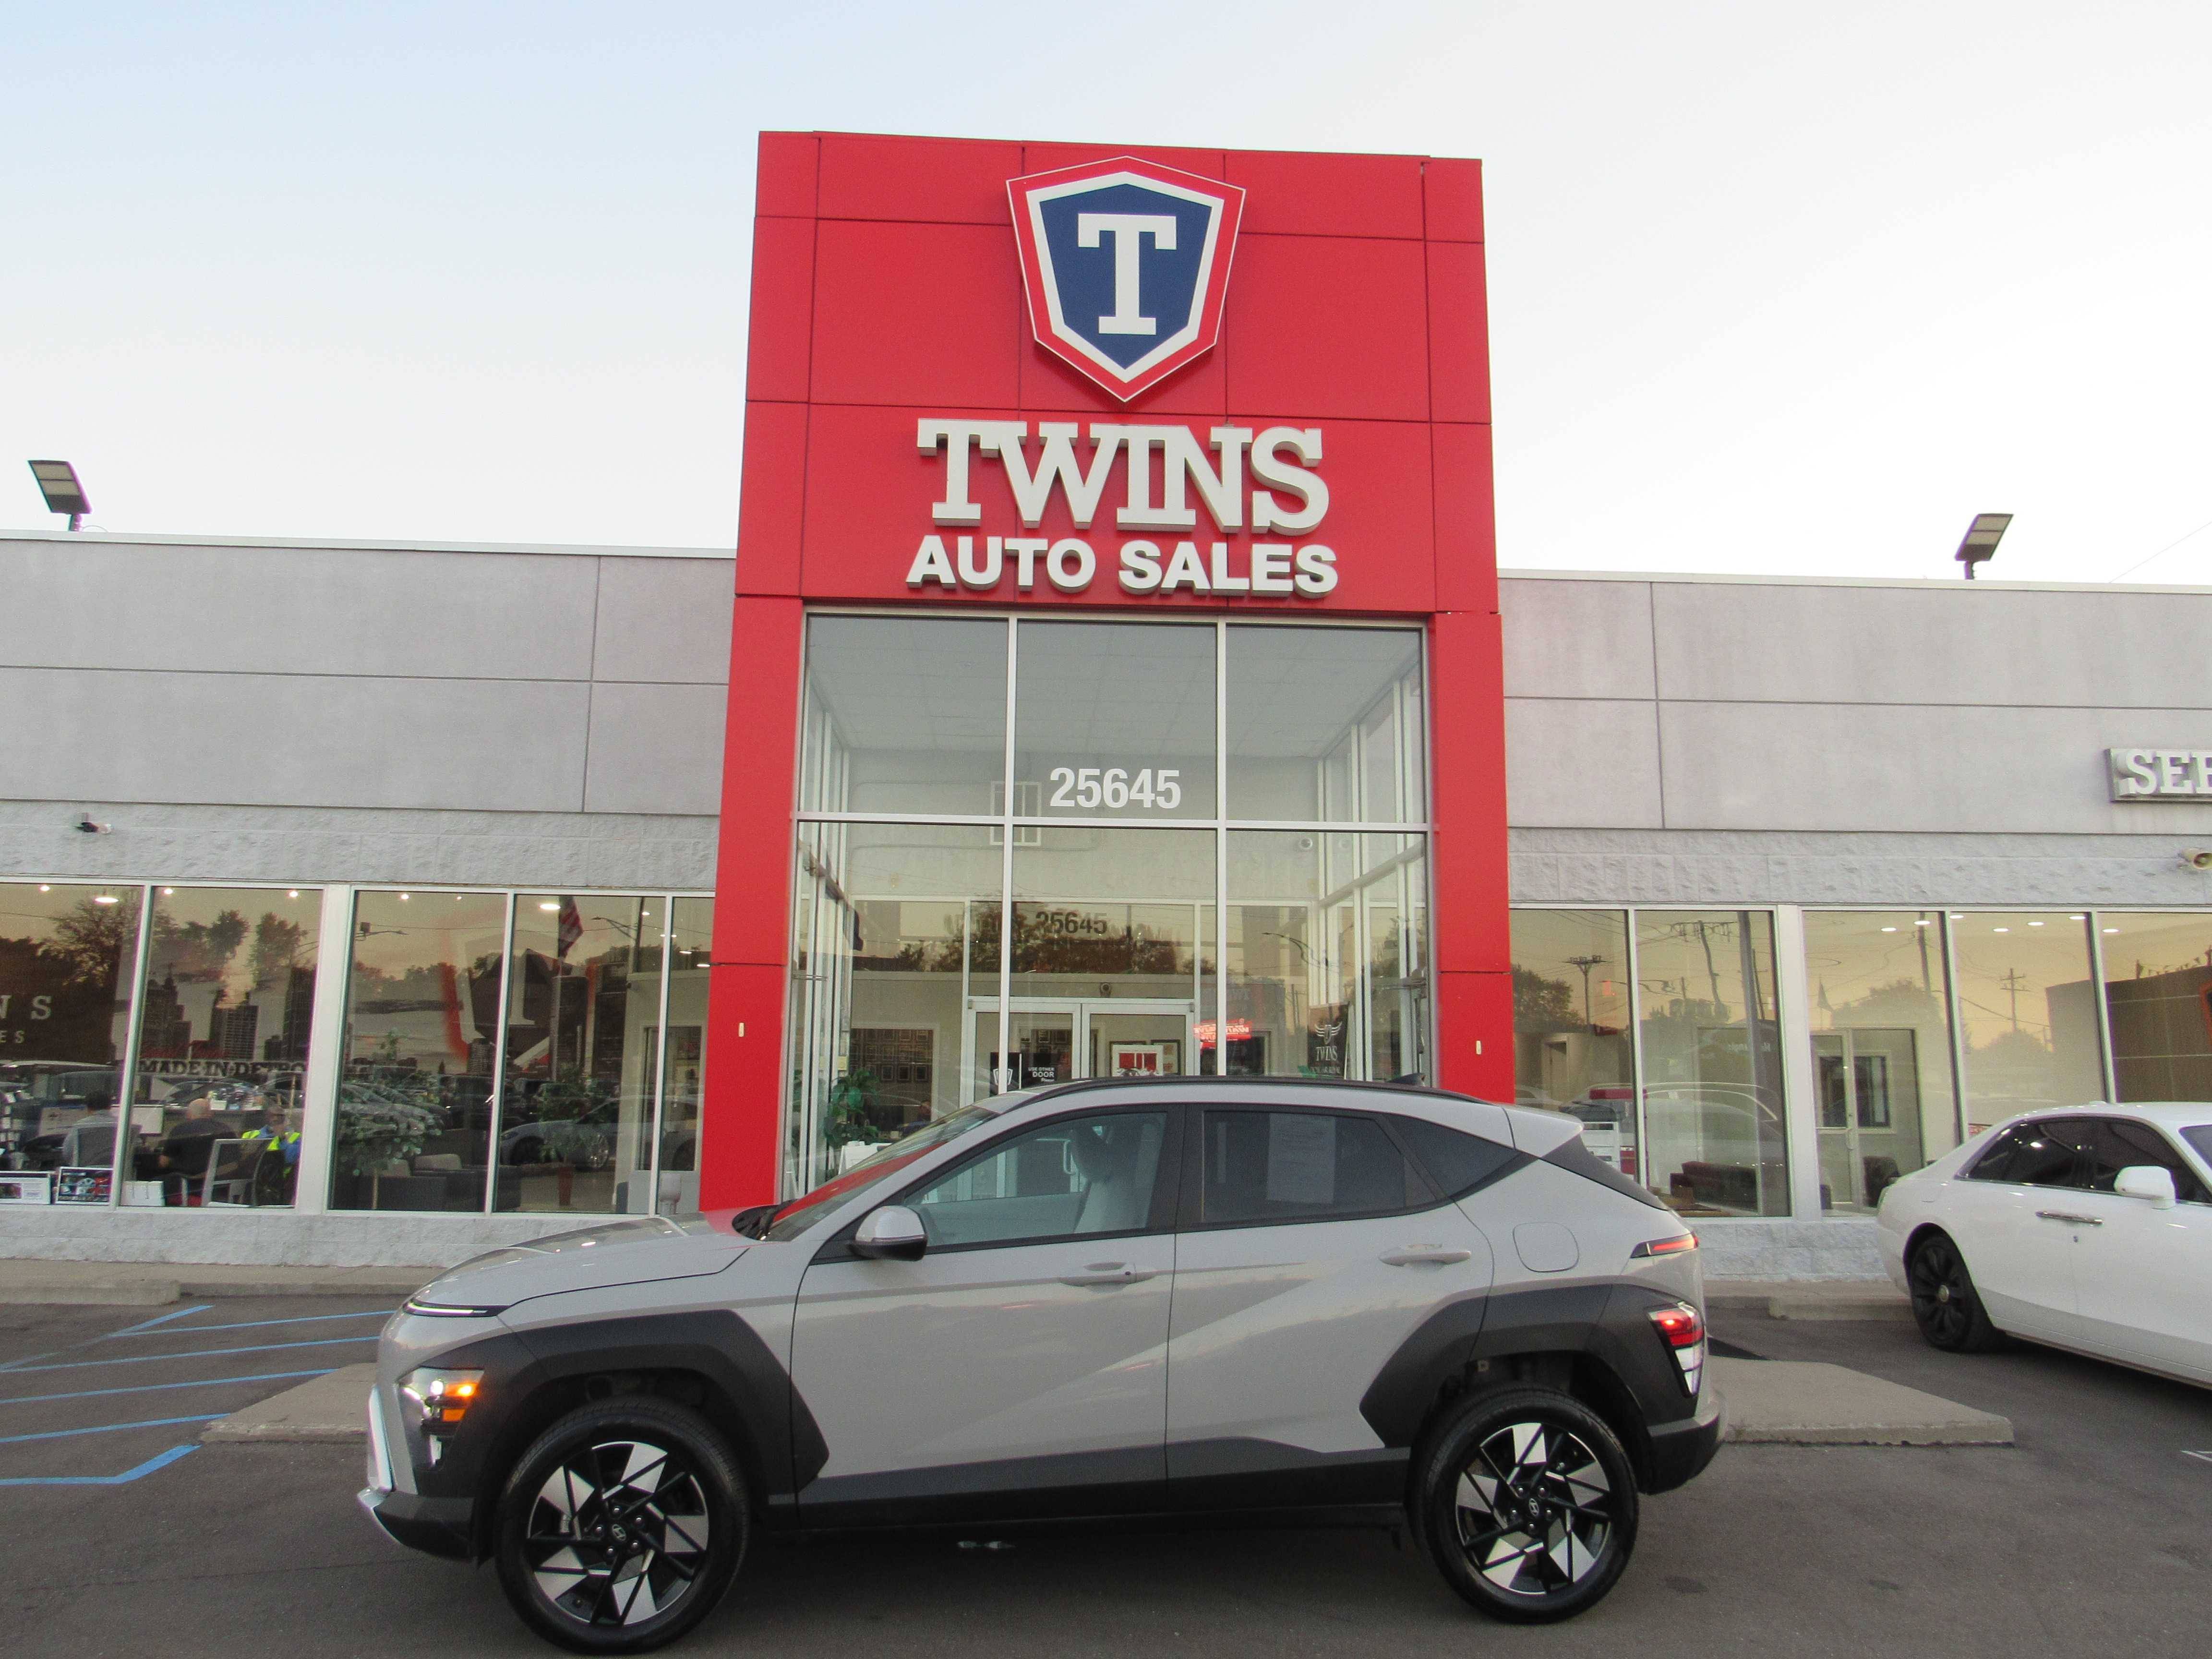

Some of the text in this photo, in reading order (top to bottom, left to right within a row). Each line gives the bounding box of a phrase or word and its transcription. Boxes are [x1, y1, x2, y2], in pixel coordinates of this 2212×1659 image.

[1078, 213, 1177, 336] T
[917, 418, 1329, 536] TWINS
[906, 535, 1338, 599] AUTO SALES
[1050, 767, 1181, 809] 25645
[1036, 911, 1108, 935] 25645
[137, 1059, 203, 1075] MADE
